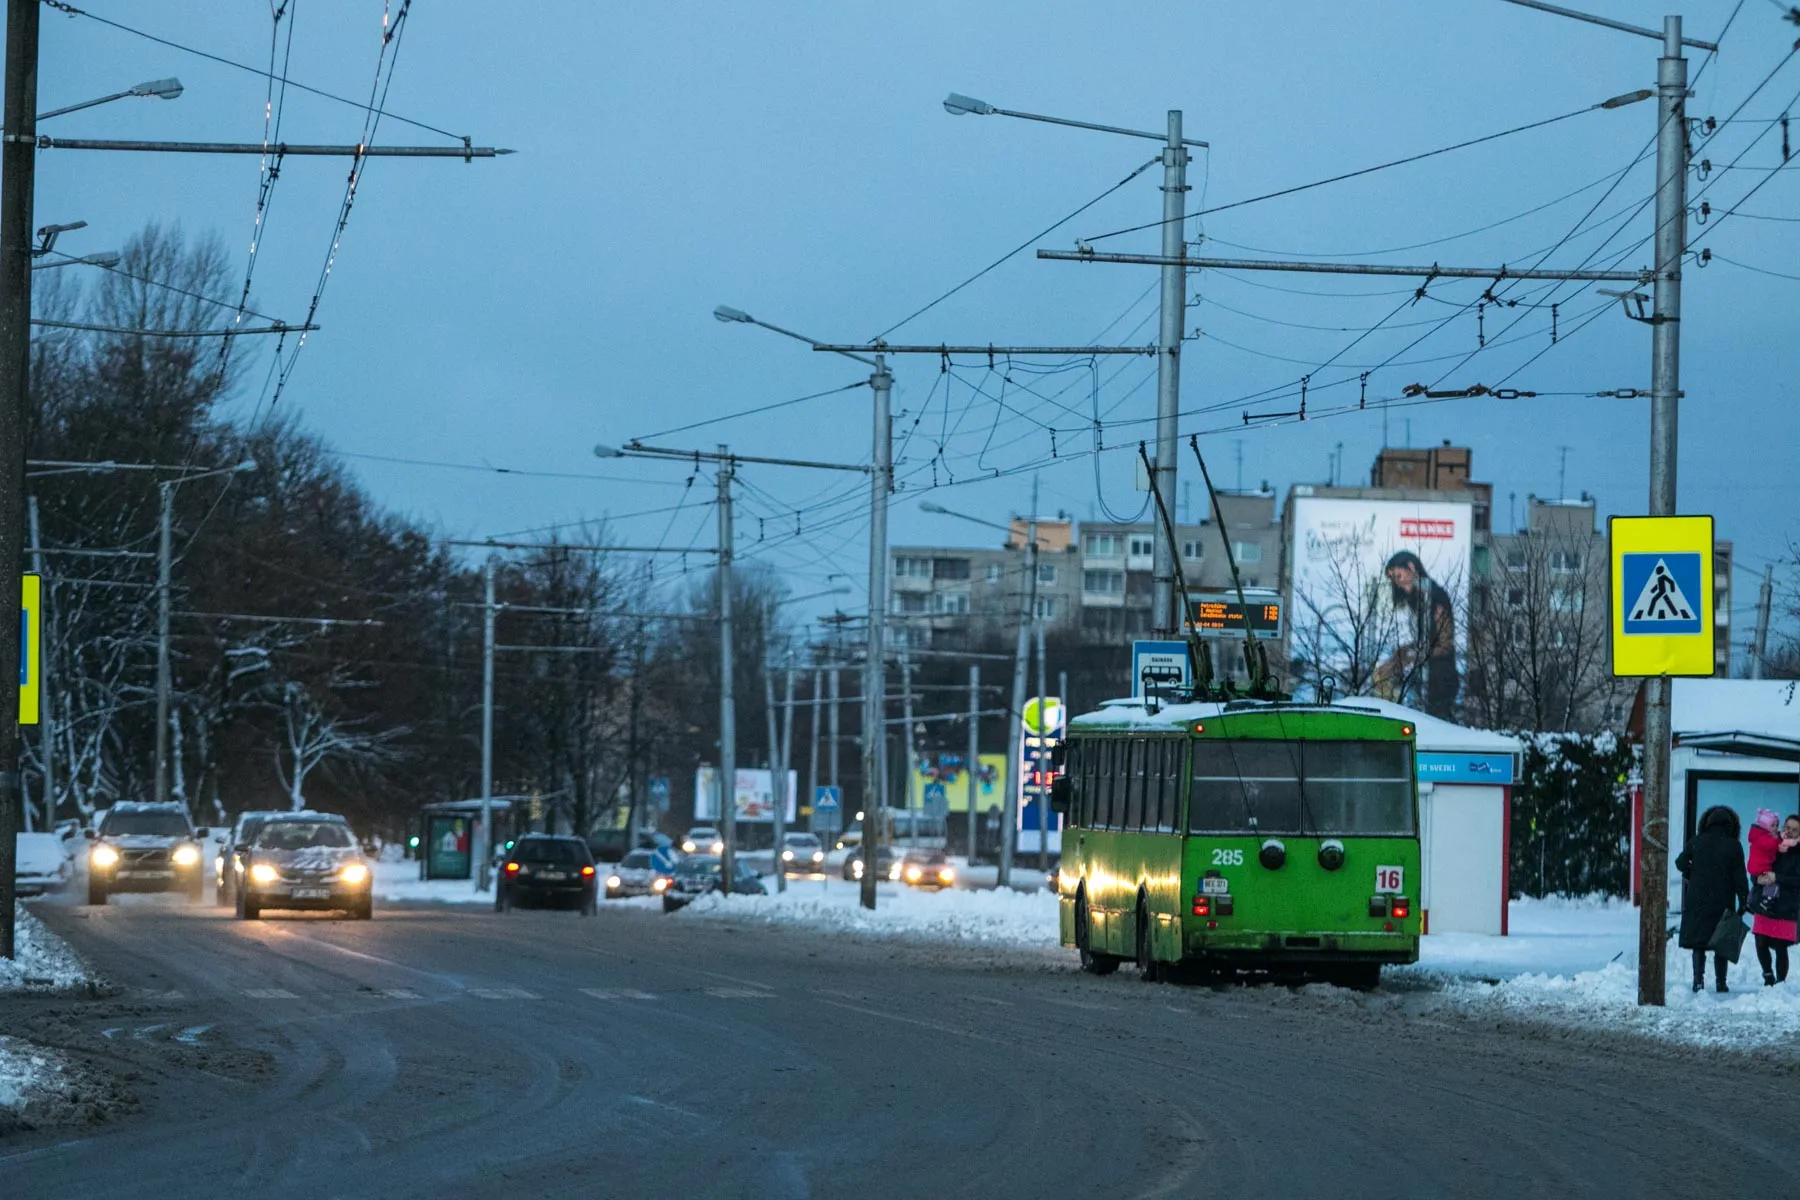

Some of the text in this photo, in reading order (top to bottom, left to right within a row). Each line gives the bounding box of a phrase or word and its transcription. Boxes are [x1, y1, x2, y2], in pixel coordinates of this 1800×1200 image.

[1401, 522, 1454, 533] FRANKE
[1211, 848, 1244, 867] 285
[1378, 869, 1400, 889] 16
